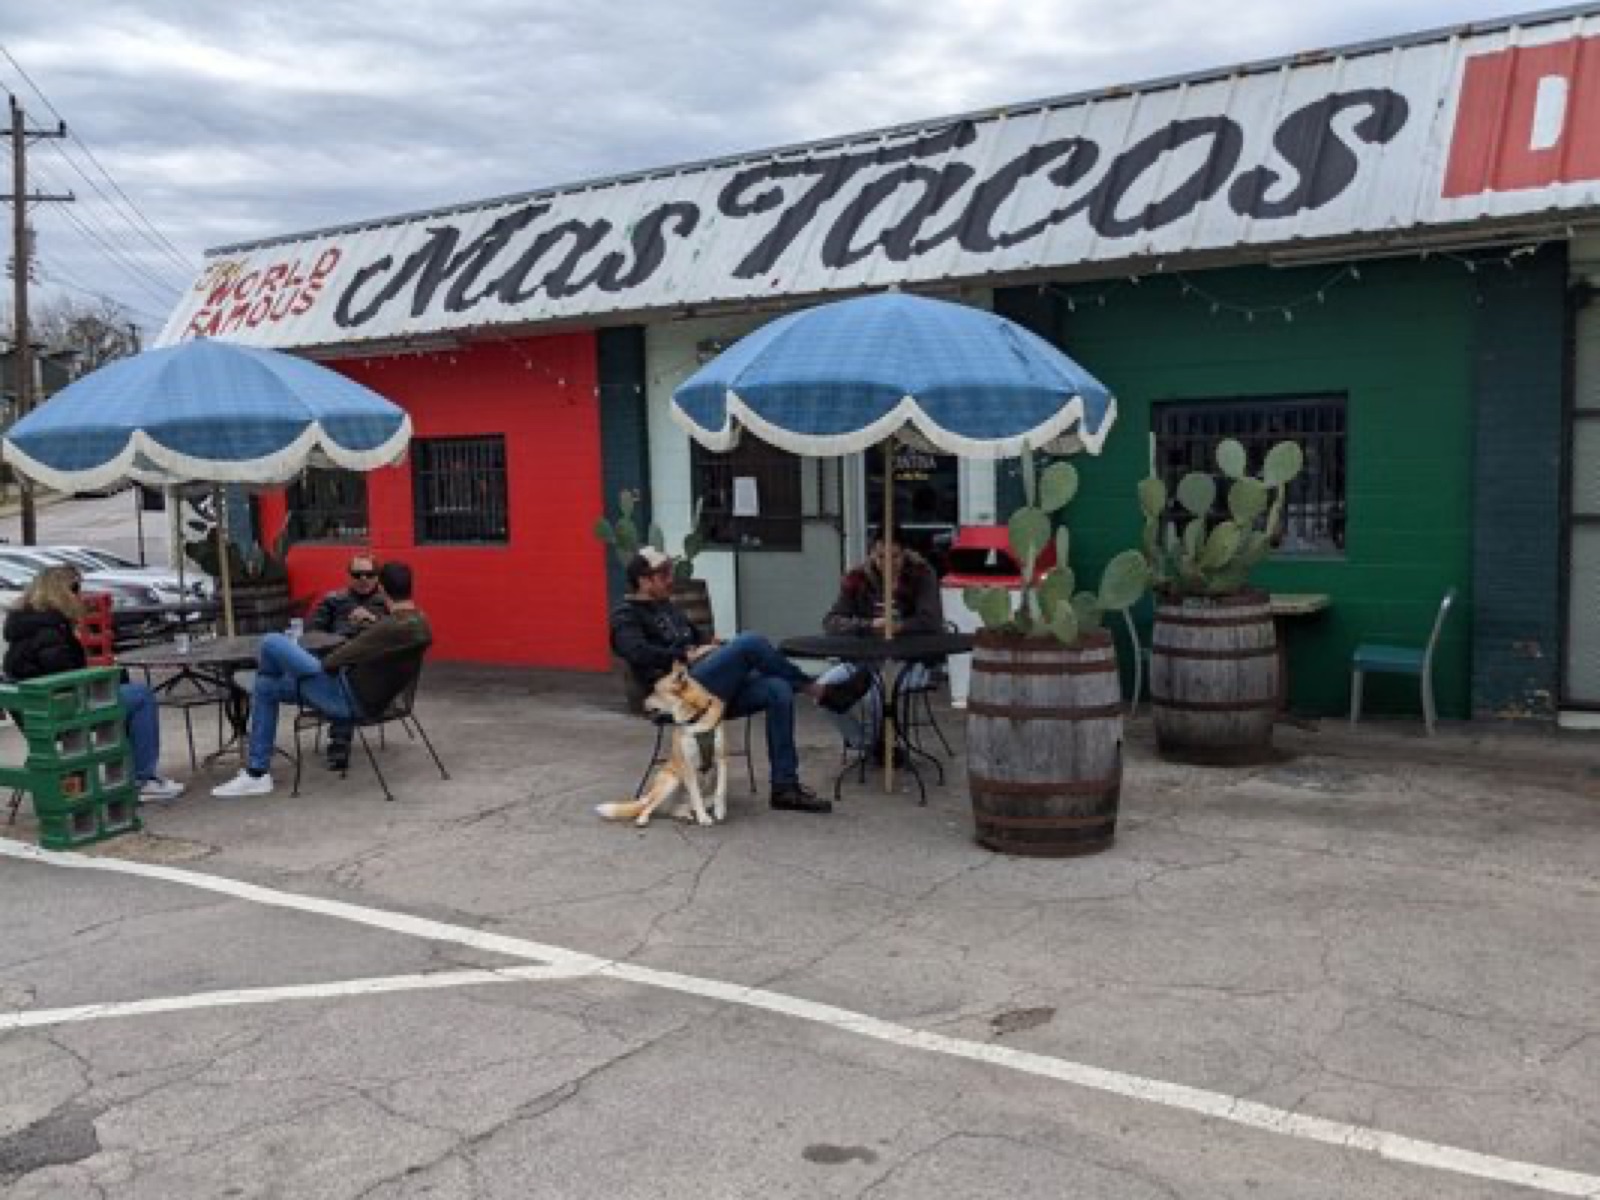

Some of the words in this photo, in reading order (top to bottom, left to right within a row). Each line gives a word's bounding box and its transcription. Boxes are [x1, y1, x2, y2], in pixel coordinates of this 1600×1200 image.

[334, 200, 700, 328] Mas
[717, 88, 1409, 279] Tacos
[206, 247, 341, 306] WORLD
[182, 290, 316, 337] FAMOUS
